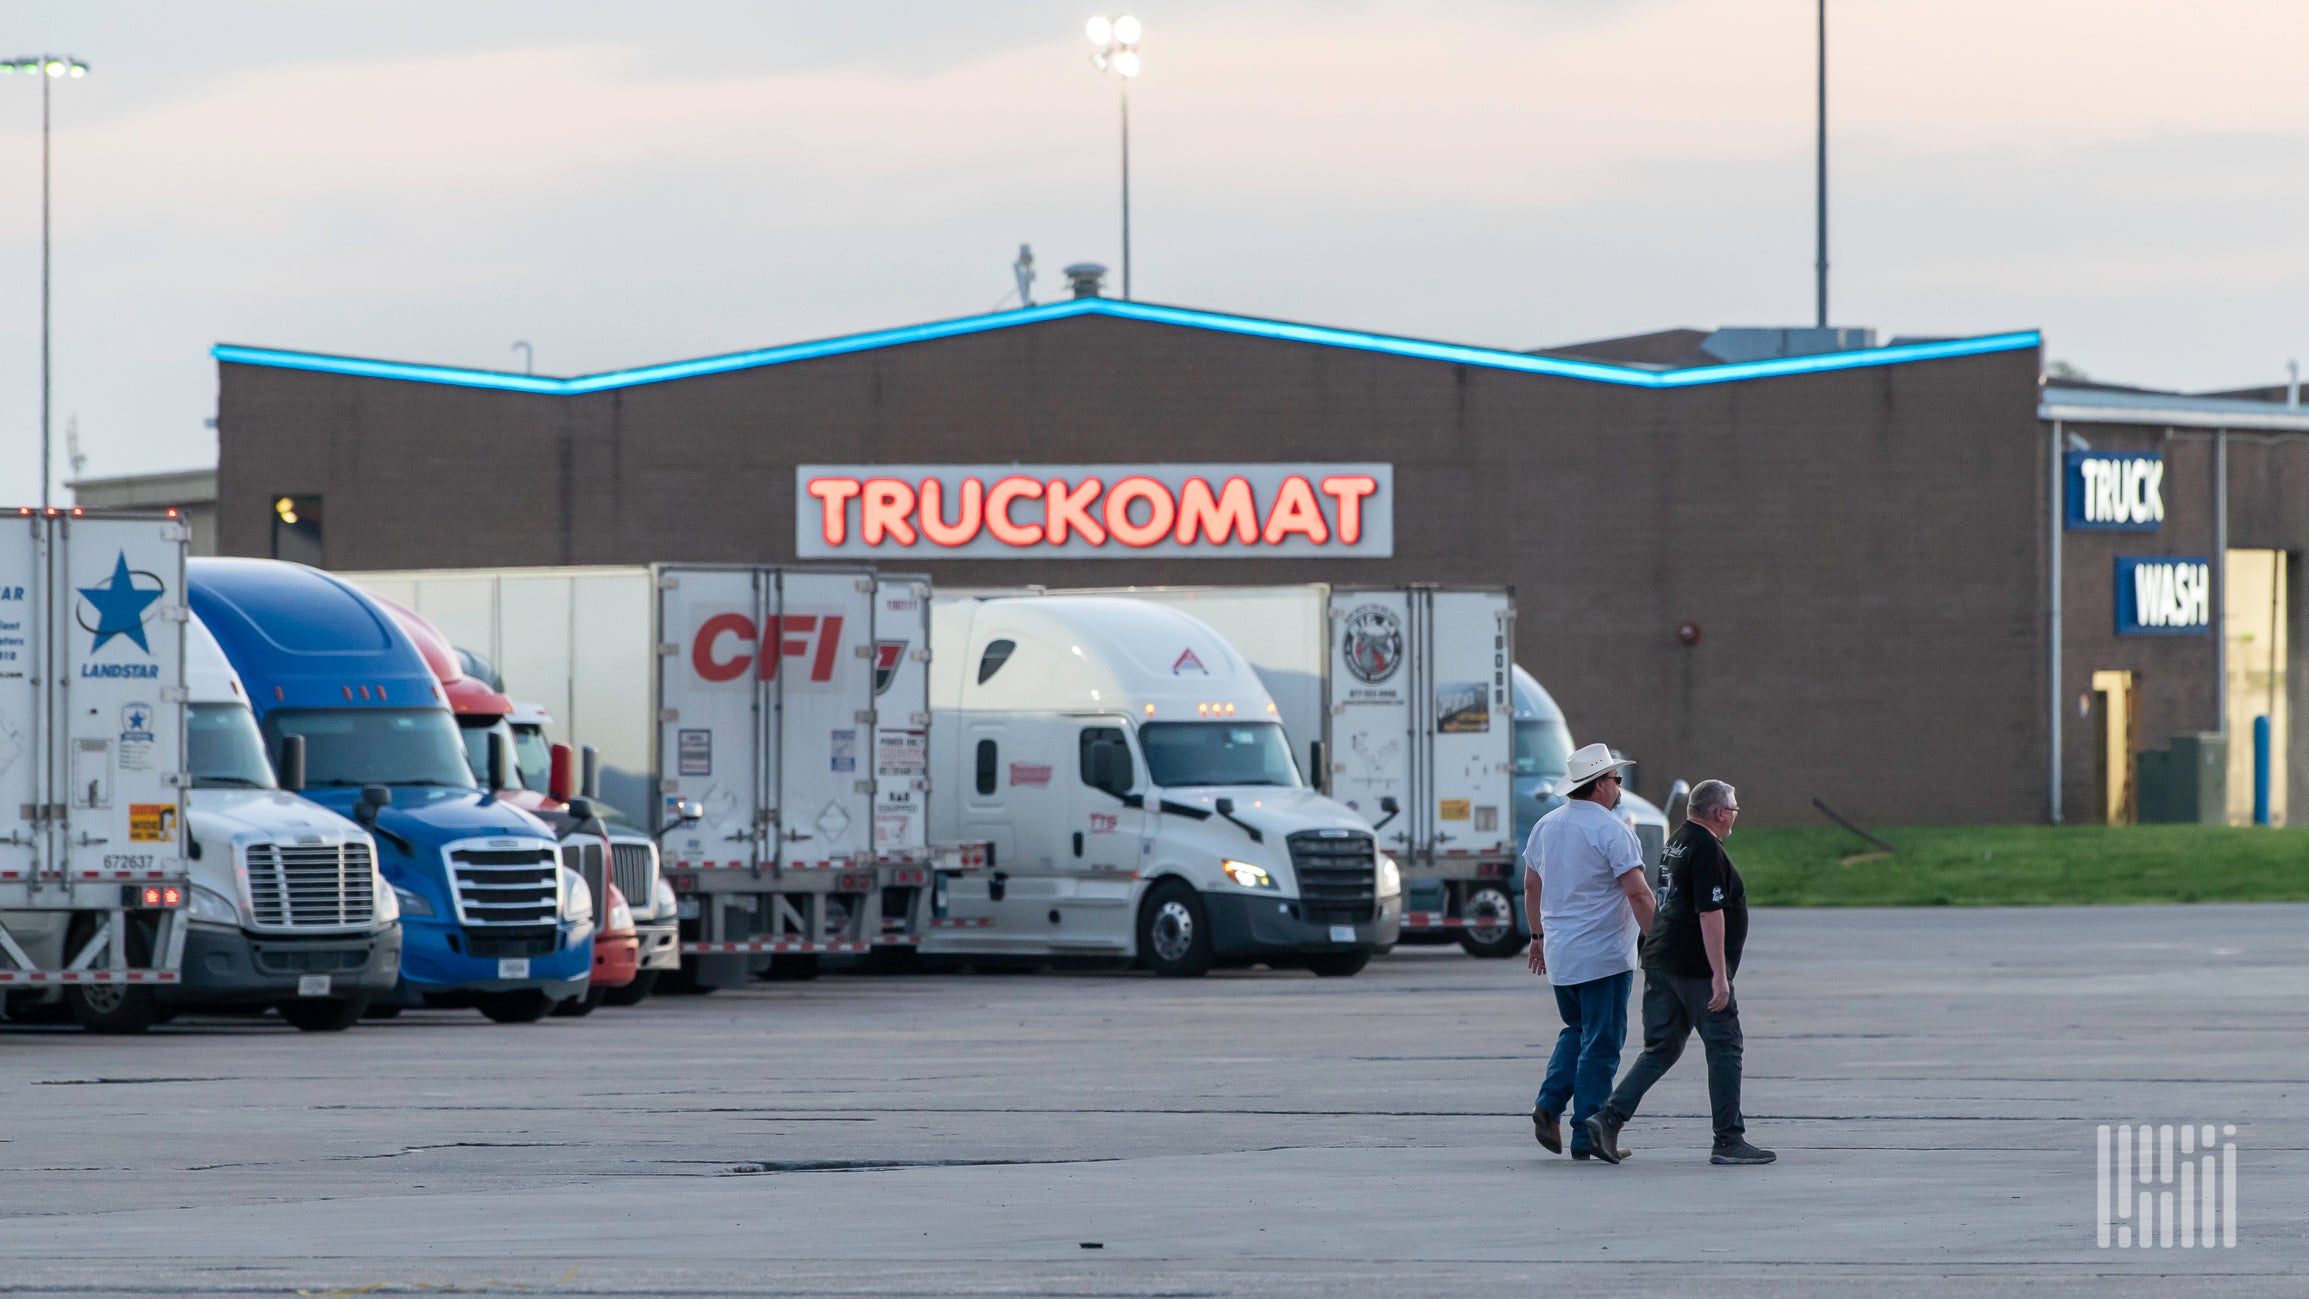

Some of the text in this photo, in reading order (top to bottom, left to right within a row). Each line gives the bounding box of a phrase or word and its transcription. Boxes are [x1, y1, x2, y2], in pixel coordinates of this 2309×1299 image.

[807, 475, 1377, 546] TRUCKOMAT
[2081, 458, 2164, 524] TRUCK
[0, 586, 24, 600] AR
[2135, 562, 2209, 627] WASH
[81, 663, 159, 678] LANDSTAR
[692, 612, 844, 683] CFI
[104, 855, 154, 869] 672637
